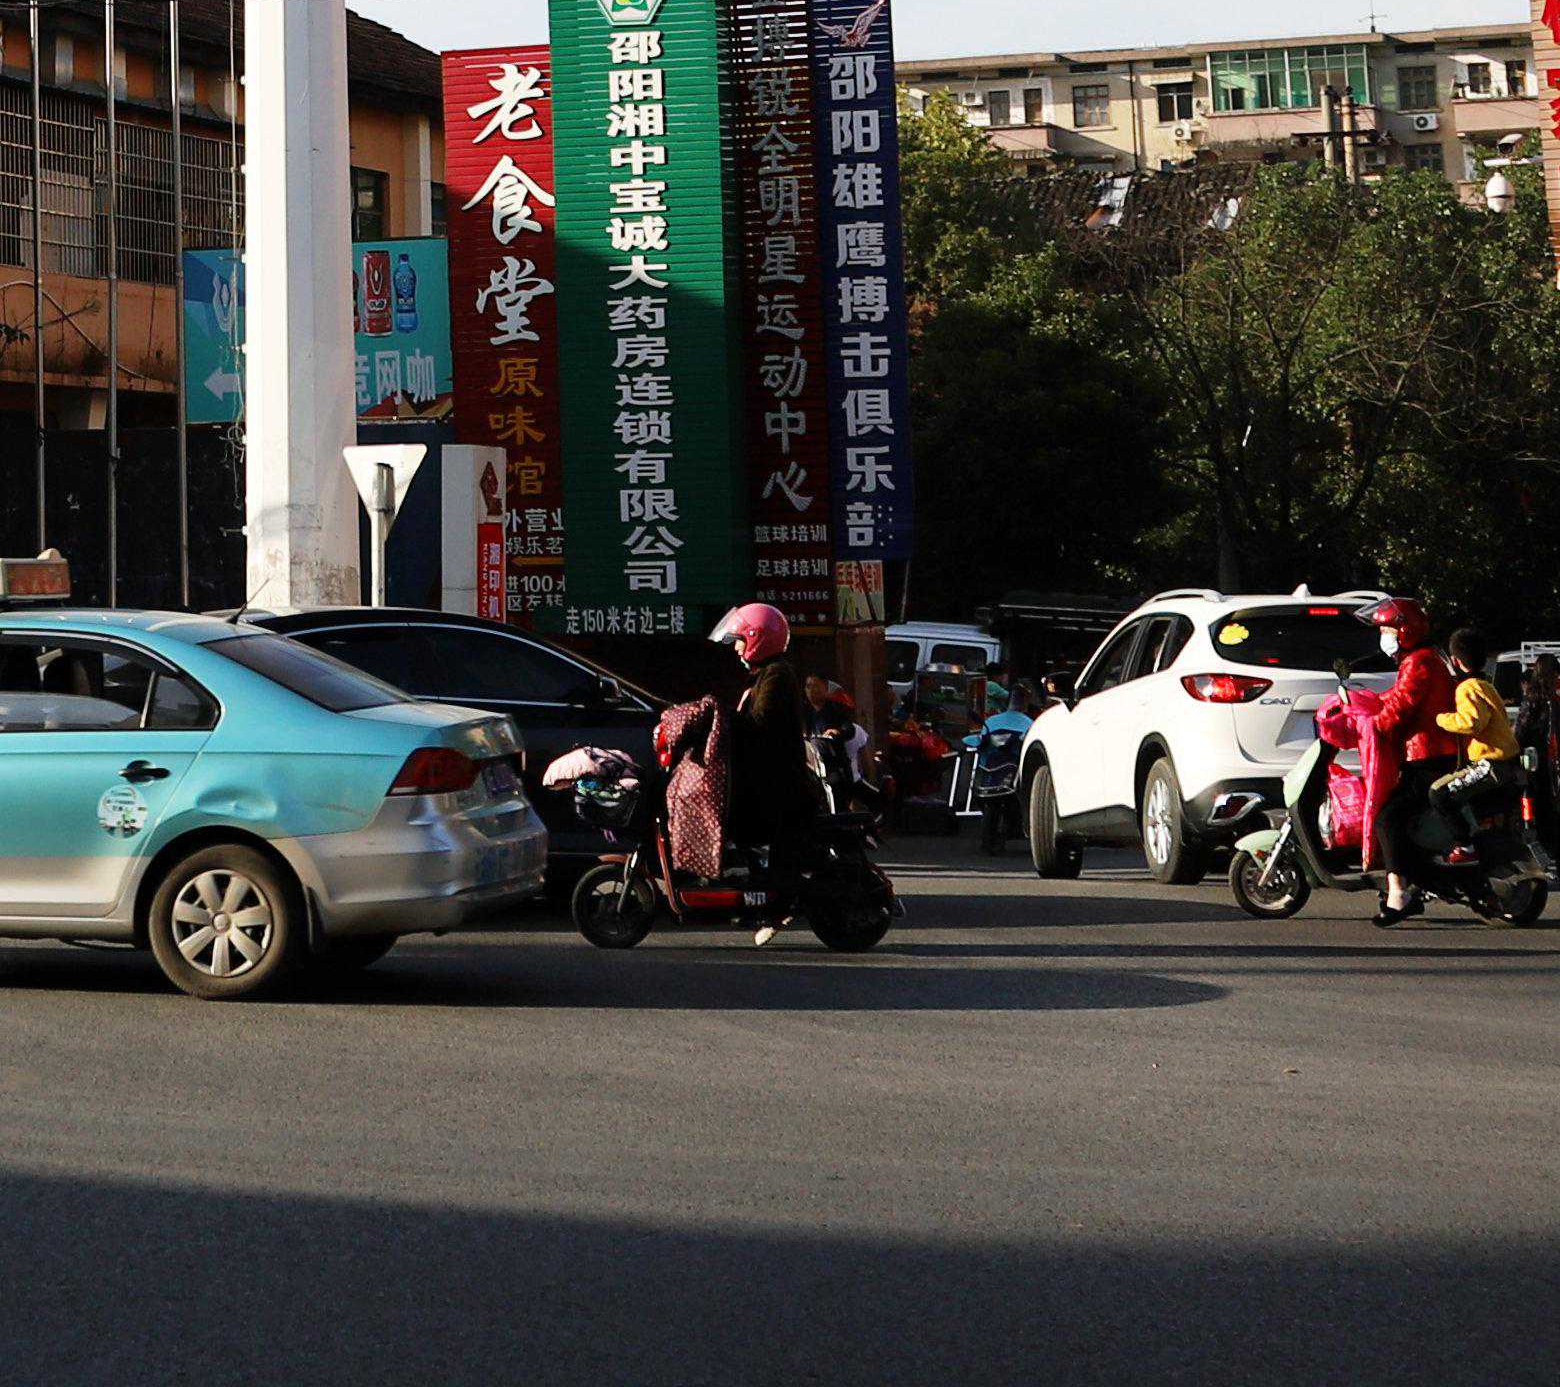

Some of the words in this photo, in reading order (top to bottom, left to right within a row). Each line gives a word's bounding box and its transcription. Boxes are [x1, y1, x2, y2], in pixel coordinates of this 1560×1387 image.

[461, 63, 556, 347] 老食堂
[606, 29, 684, 596] 邵阳湘中宝诚大药房连锁有限公司
[753, 524, 828, 544] 篮球培训
[755, 558, 829, 578] 足球培训
